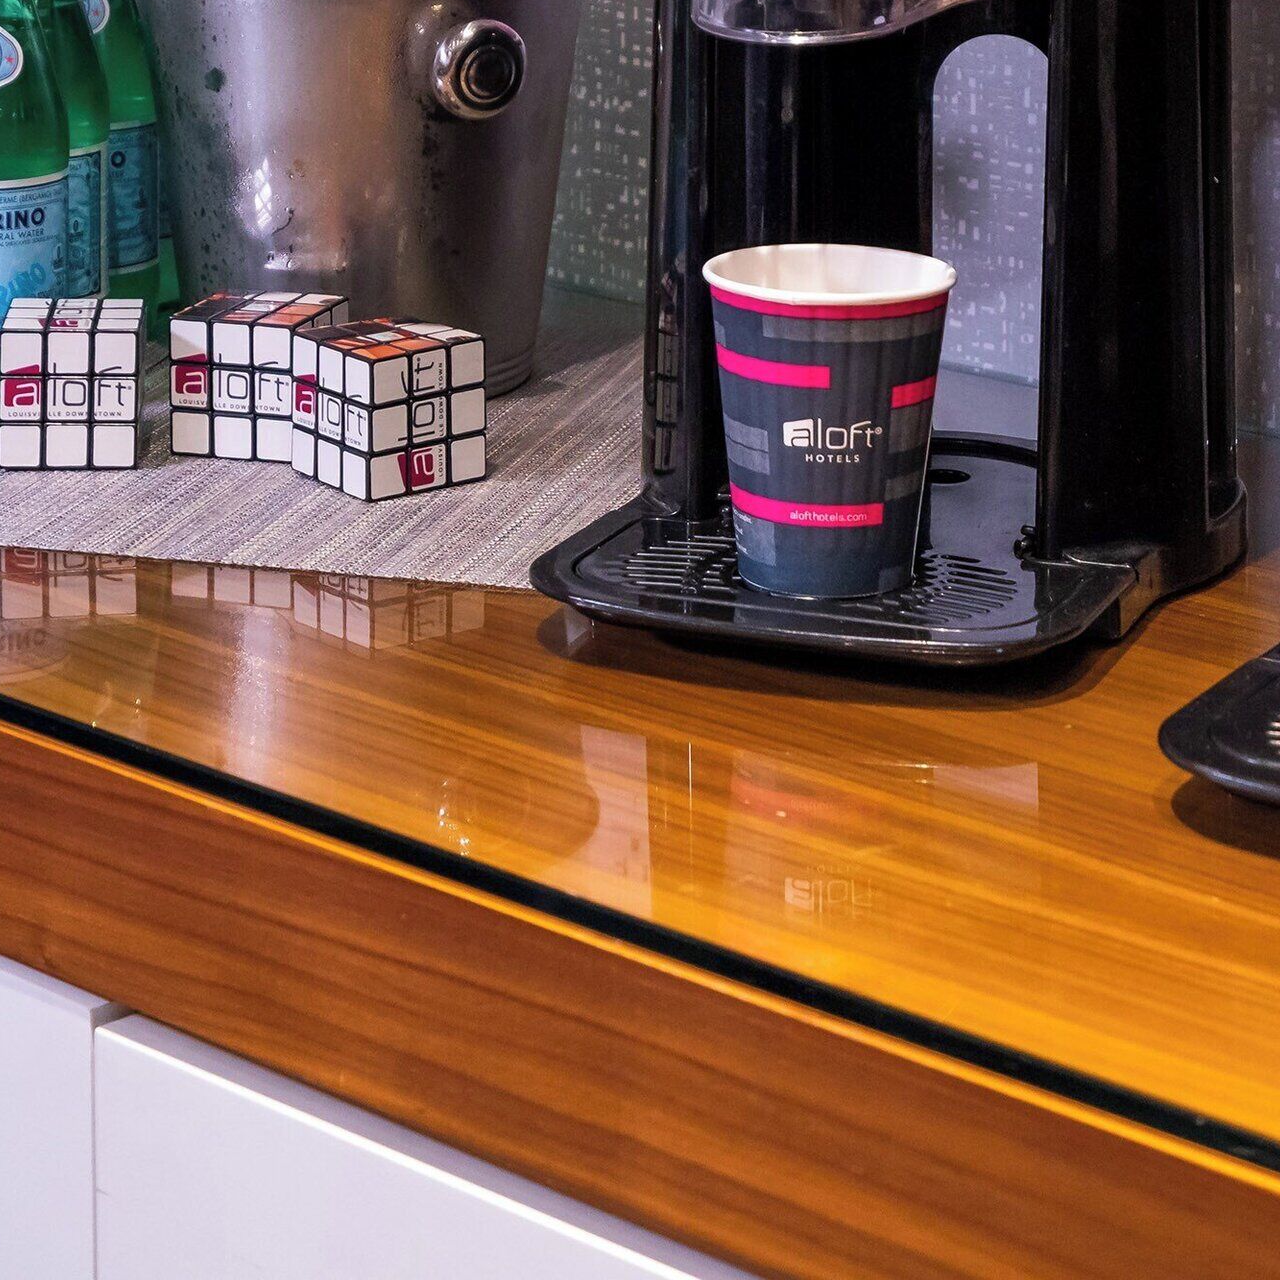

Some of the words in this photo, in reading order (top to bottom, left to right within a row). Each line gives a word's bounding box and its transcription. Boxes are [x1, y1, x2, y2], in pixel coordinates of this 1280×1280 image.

[17, 228, 45, 239] WATER
[4, 362, 128, 407] aloft
[175, 353, 285, 402] aloft
[296, 374, 364, 437] aloft
[397, 360, 435, 488] aloft
[782, 418, 875, 450] aloft
[805, 453, 860, 463] HOTELS
[790, 510, 868, 522] alofthotels.com
